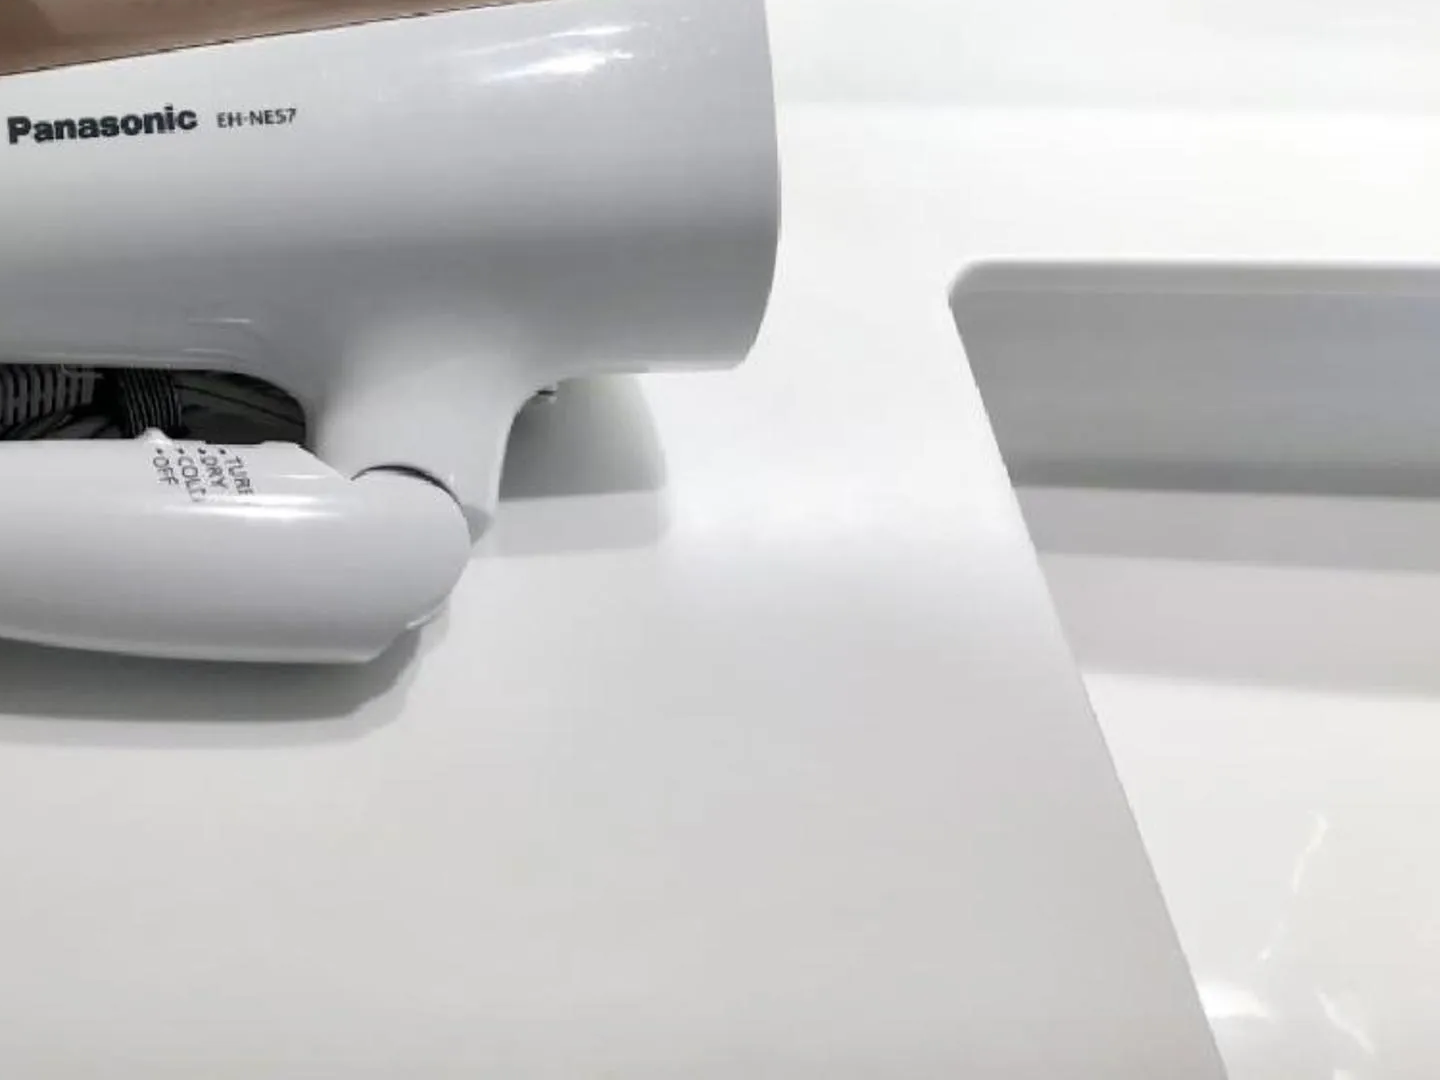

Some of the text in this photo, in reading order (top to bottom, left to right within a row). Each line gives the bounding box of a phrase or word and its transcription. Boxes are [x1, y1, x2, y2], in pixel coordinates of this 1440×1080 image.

[7, 103, 298, 145] Panasonic EH-NE57
[152, 455, 179, 485] OFF
[200, 456, 229, 489] DRY
